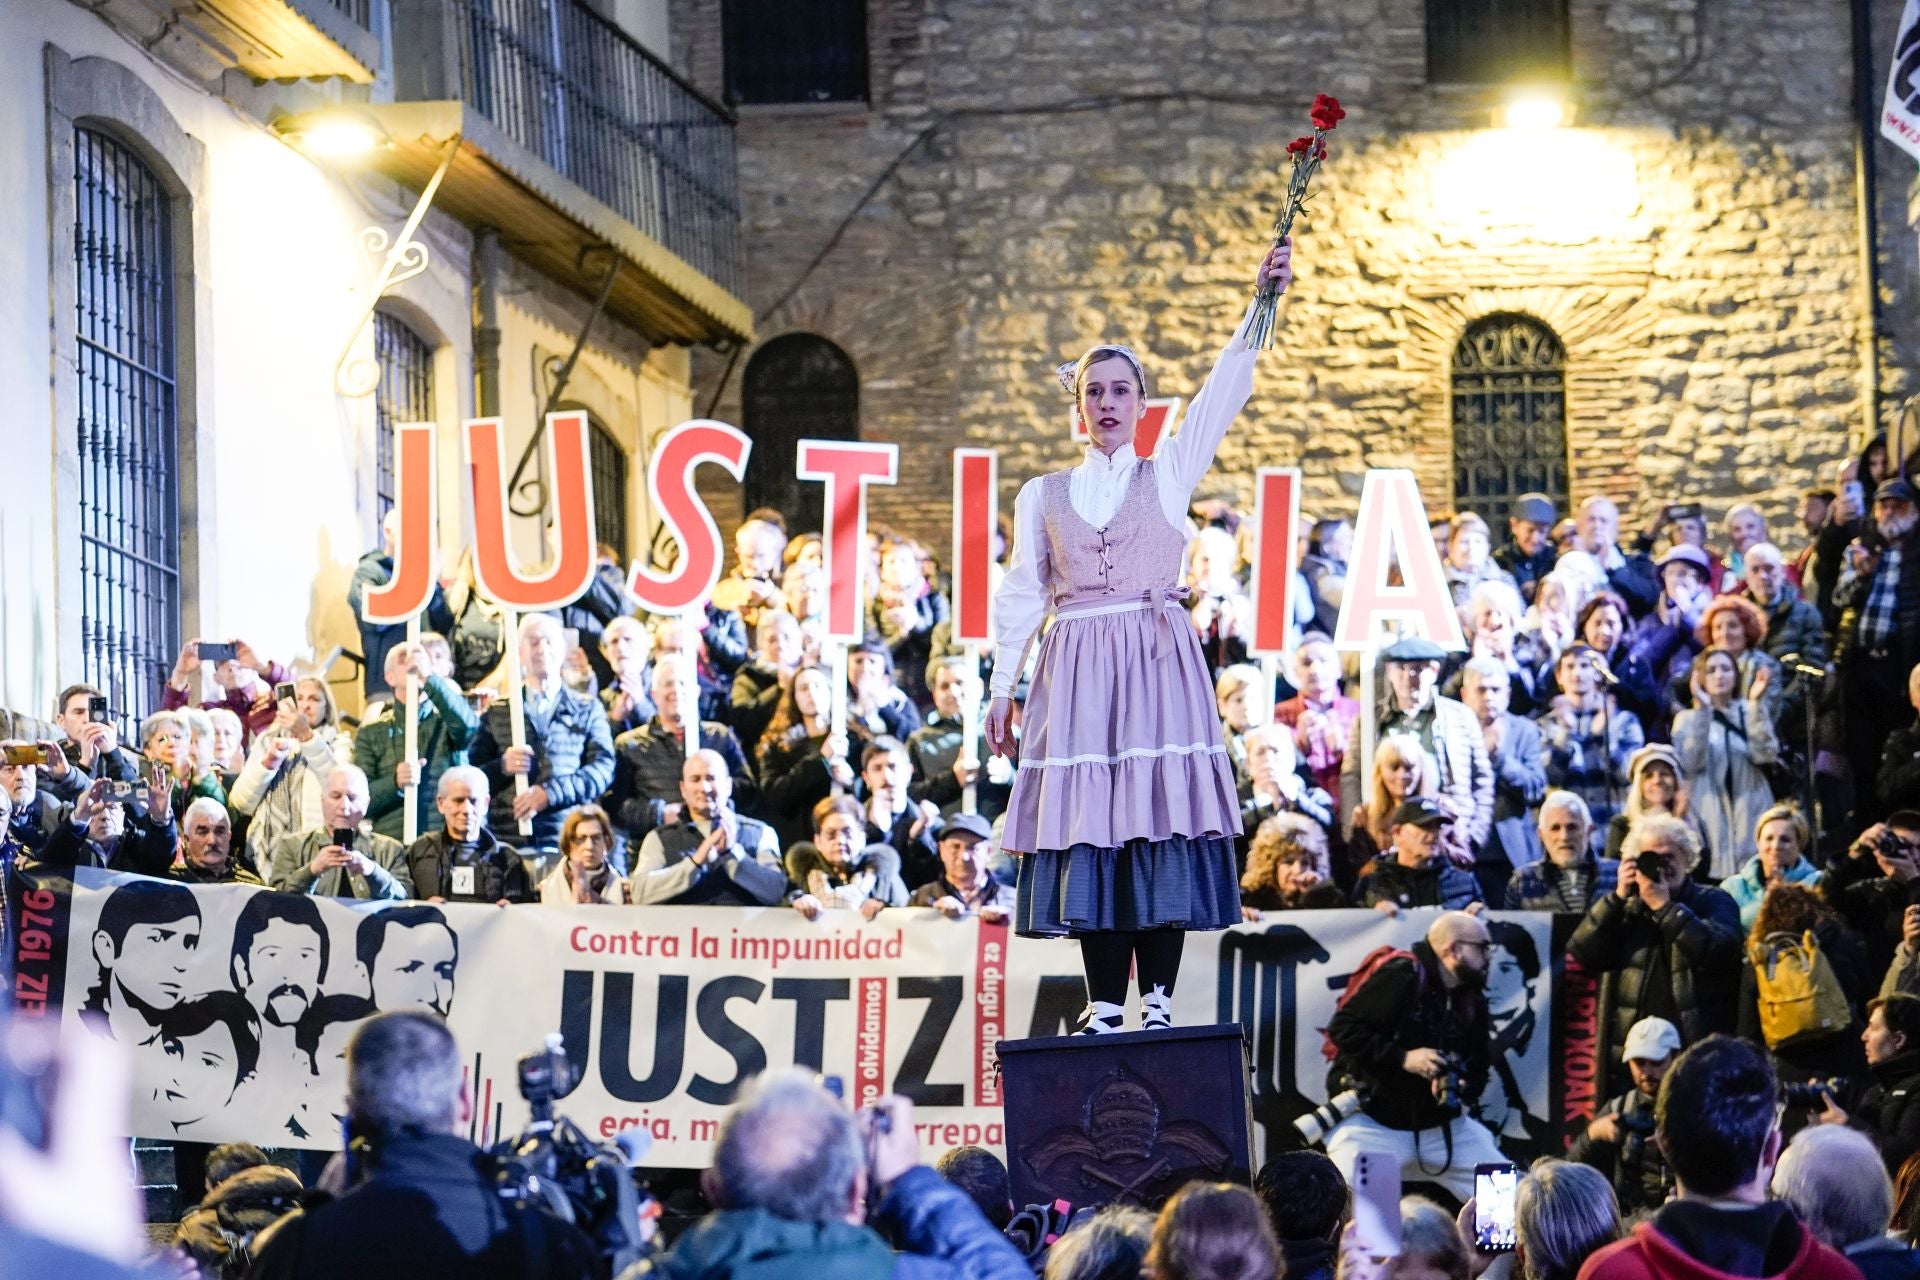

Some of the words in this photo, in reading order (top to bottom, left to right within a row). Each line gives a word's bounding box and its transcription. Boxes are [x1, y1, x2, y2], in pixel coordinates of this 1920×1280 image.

[362, 397, 1466, 657] JUSTIIA
[19, 888, 55, 962] 1976
[569, 926, 679, 958] Contra
[691, 927, 719, 960] la
[730, 927, 904, 969] impunidad
[985, 941, 1001, 963] ez
[978, 966, 1002, 1017] dugu
[859, 980, 882, 1080] olvidamos
